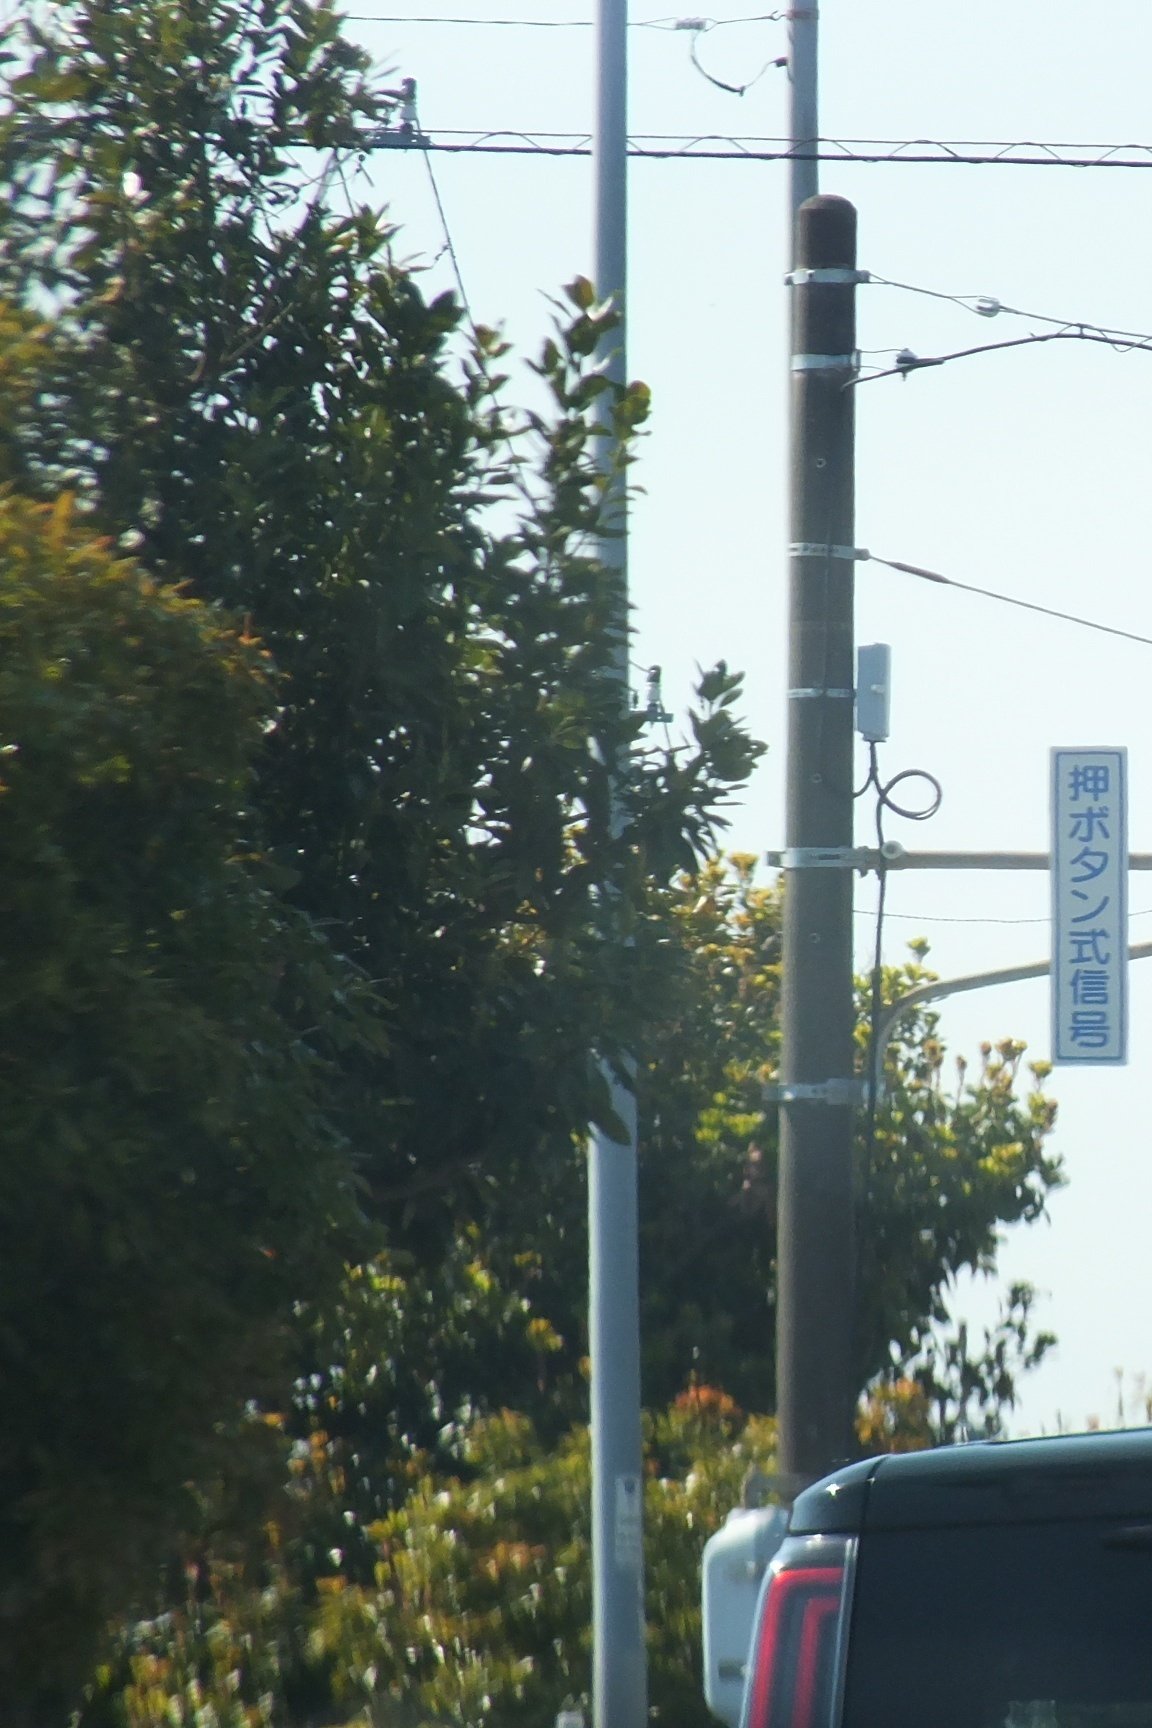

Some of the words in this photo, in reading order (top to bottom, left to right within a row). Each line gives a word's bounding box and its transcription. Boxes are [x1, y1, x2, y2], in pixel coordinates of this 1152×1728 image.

[1067, 764, 1111, 1049] 押ボタン式信号
